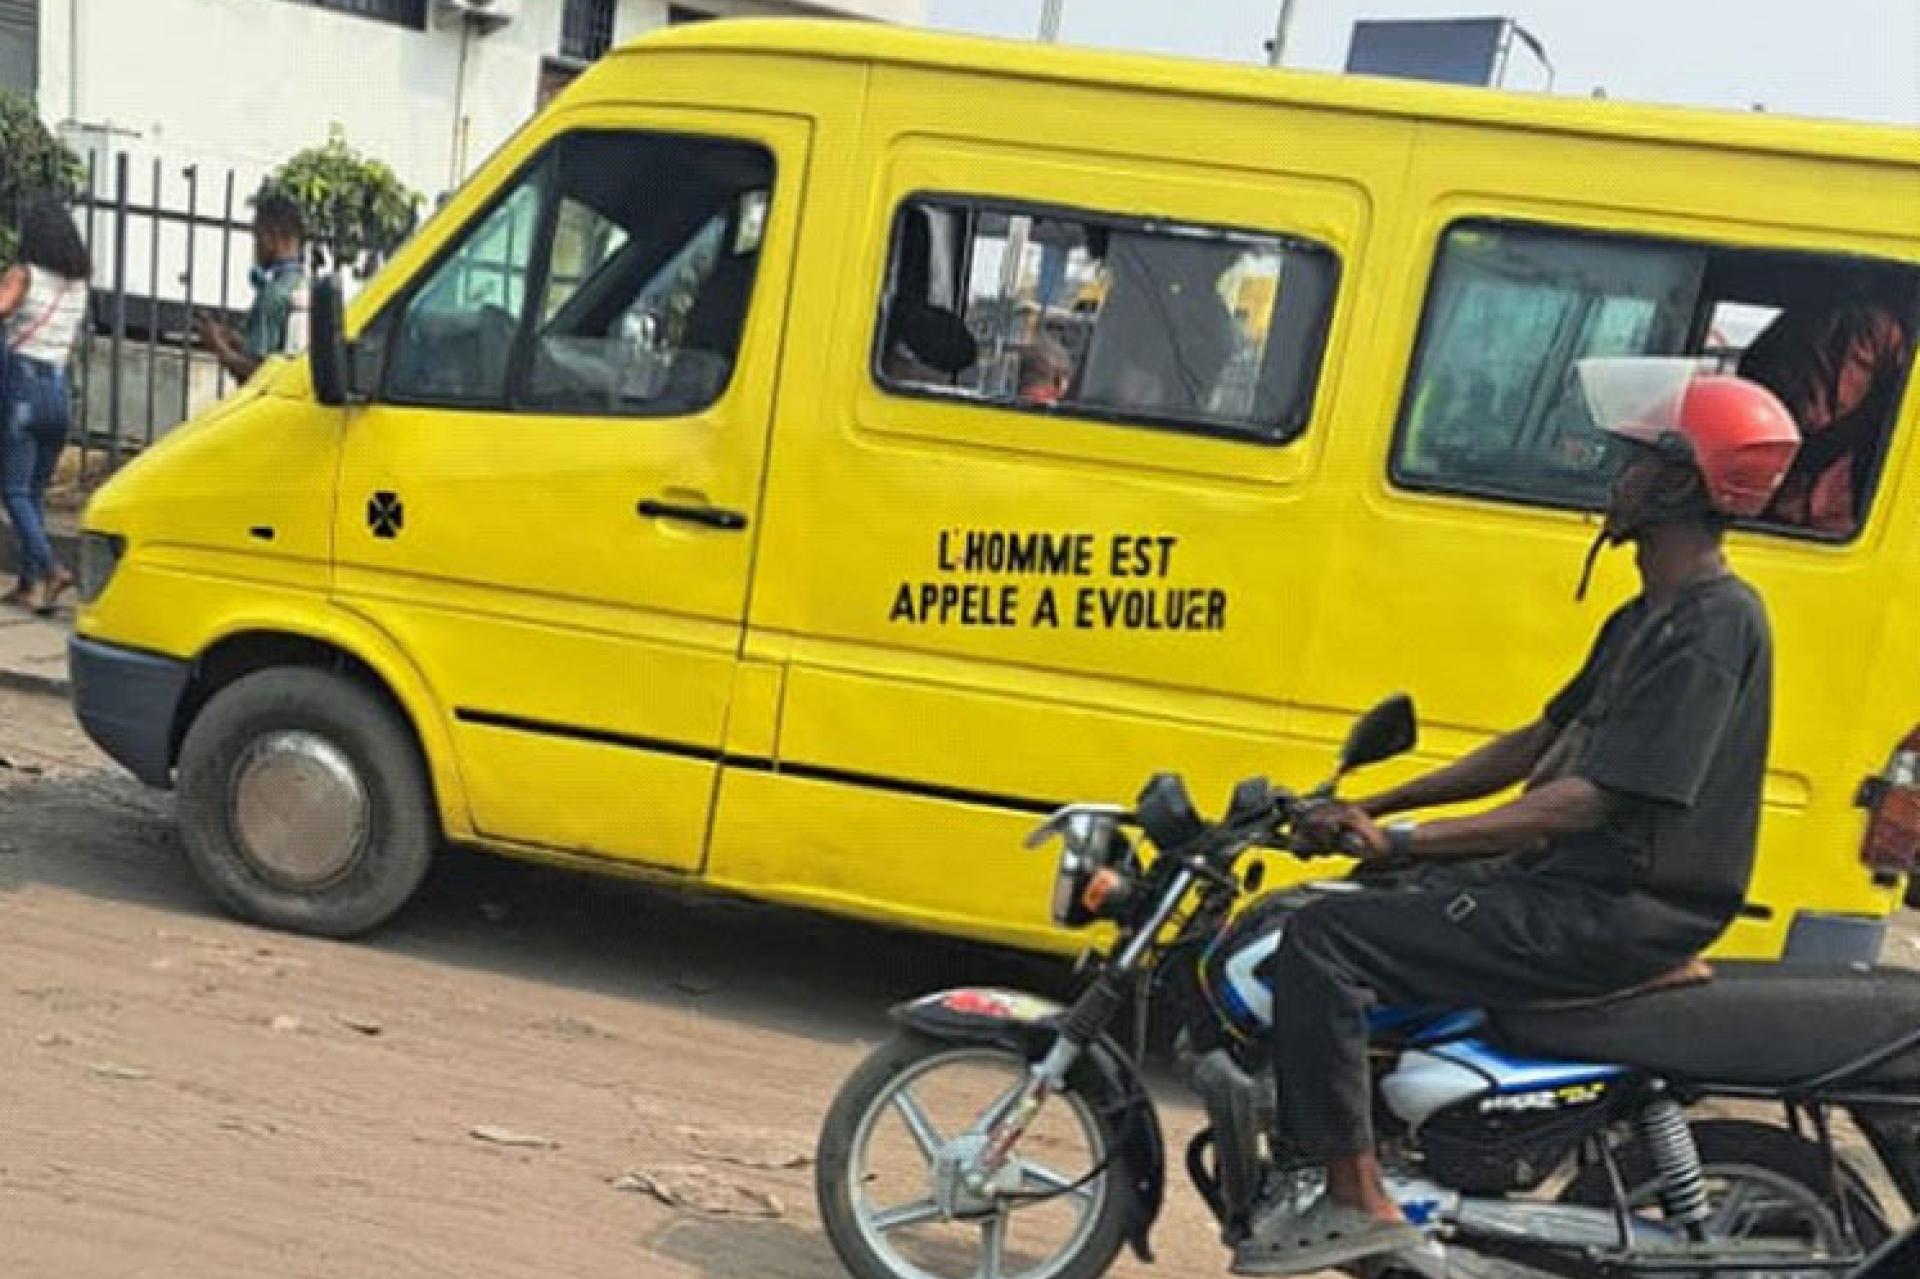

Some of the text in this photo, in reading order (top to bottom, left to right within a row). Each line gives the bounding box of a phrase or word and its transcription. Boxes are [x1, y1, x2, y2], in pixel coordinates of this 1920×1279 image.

[1110, 535, 1177, 577] EST
[889, 581, 1227, 630] APPELE A EVOLUER
